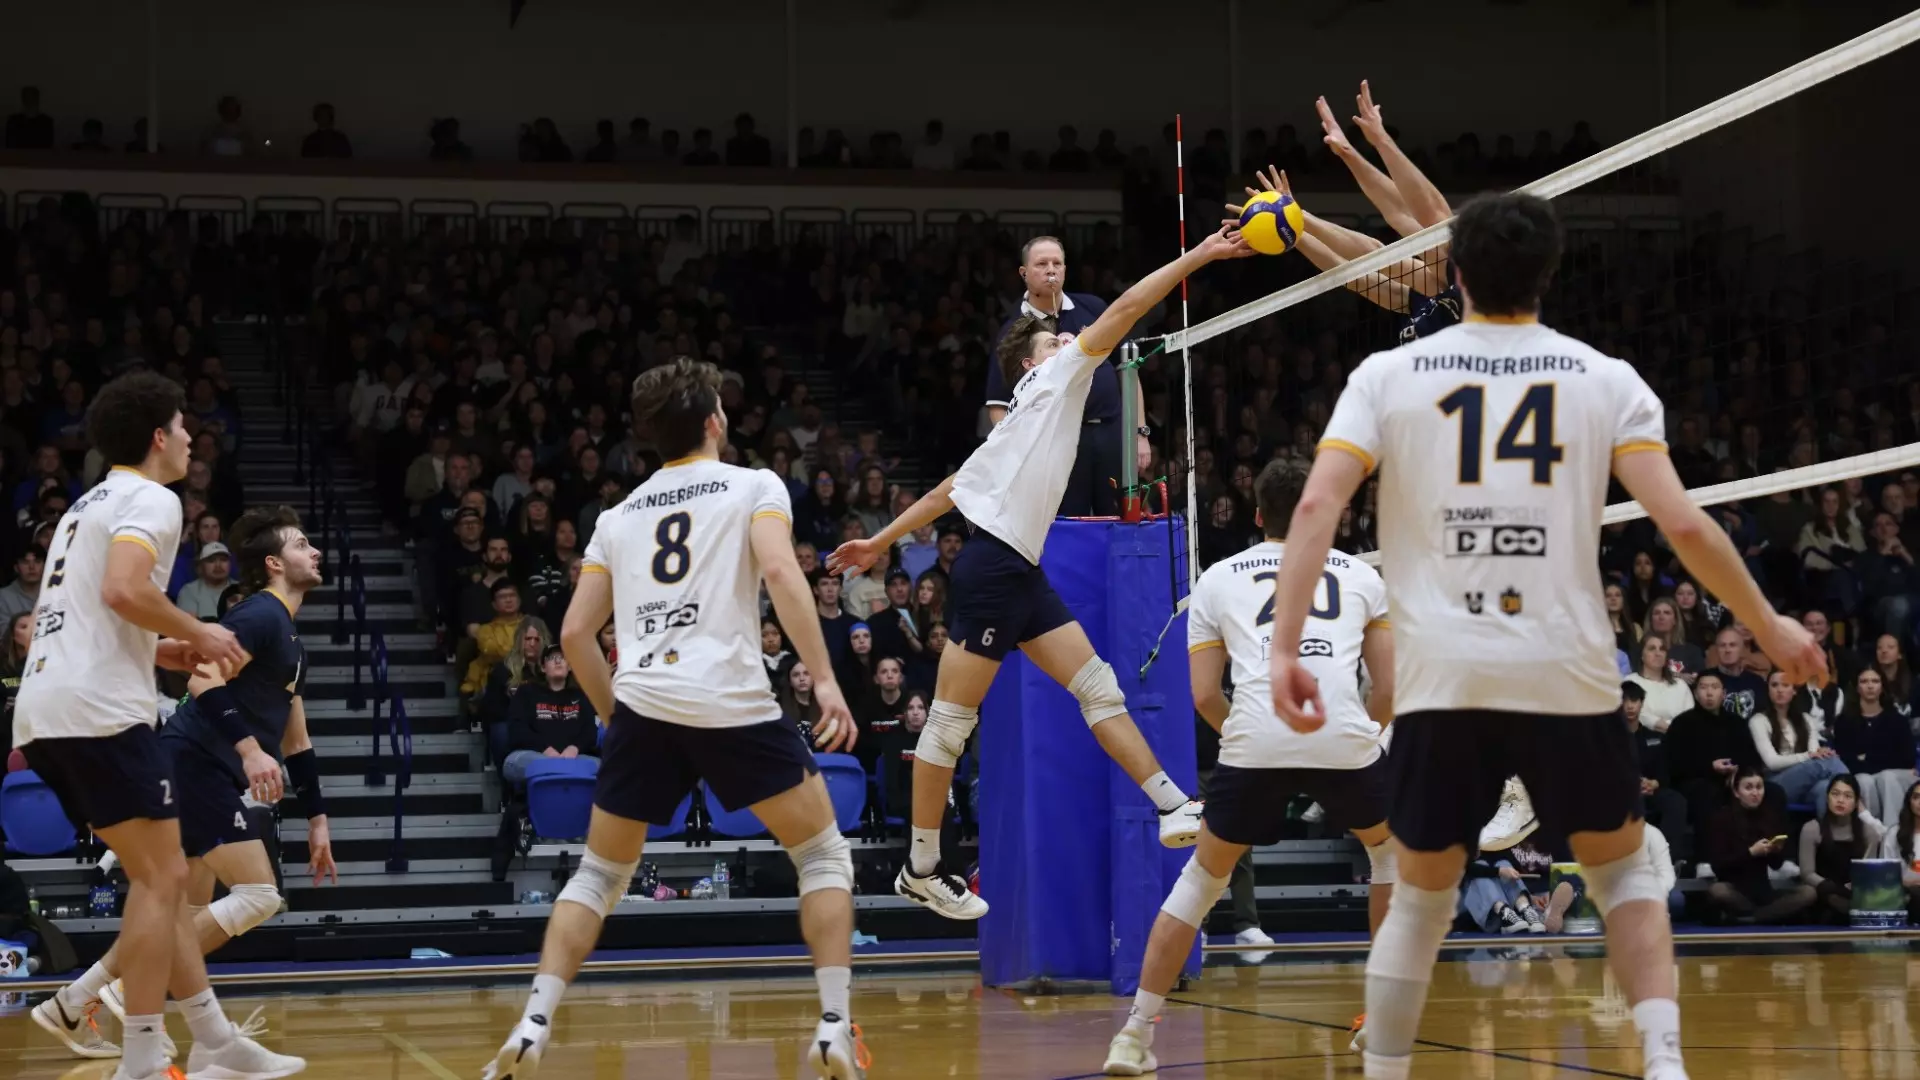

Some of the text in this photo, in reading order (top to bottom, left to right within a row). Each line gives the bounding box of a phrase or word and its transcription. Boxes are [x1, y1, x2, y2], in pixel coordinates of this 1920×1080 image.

[1412, 354, 1587, 377] THUNDERBIRDS
[1436, 380, 1565, 487] 14
[621, 480, 730, 515] THUNDERBIRDS
[651, 511, 693, 585] 8
[1231, 557, 1351, 573] THUNDRDS
[982, 627, 996, 647] 6
[160, 779, 173, 805] 2
[234, 811, 248, 831] 4
